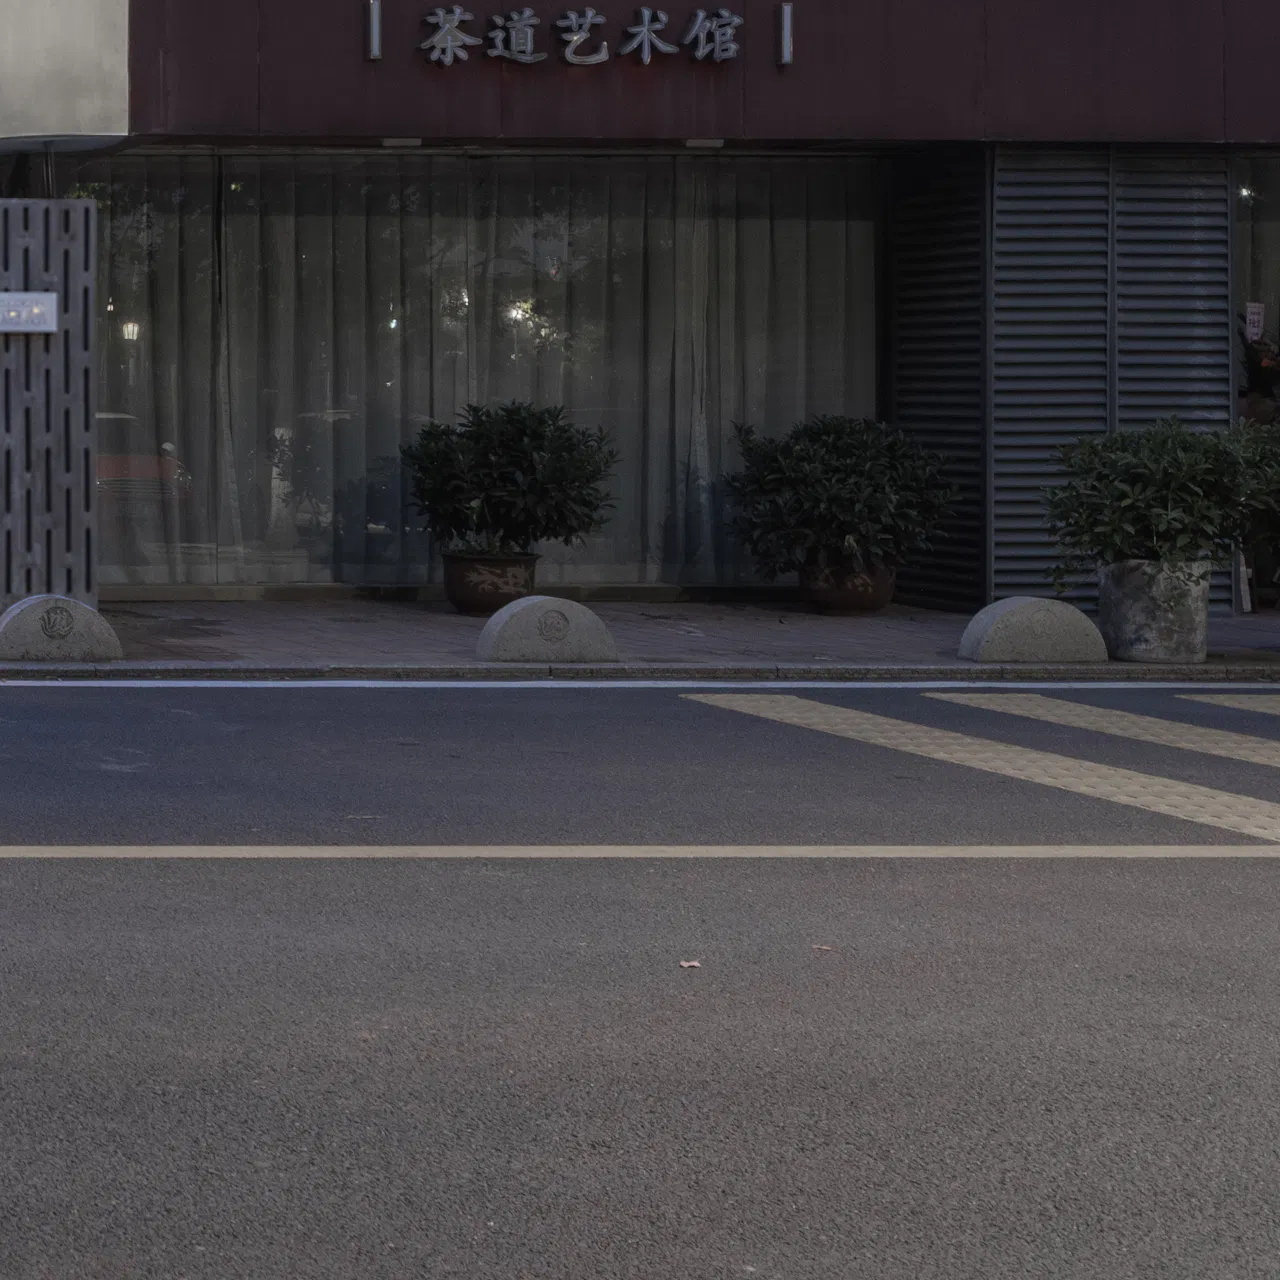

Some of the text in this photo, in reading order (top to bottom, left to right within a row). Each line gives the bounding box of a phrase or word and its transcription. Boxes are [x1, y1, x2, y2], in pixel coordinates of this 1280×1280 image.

[420, 5, 744, 66] 茶道艺术馆
